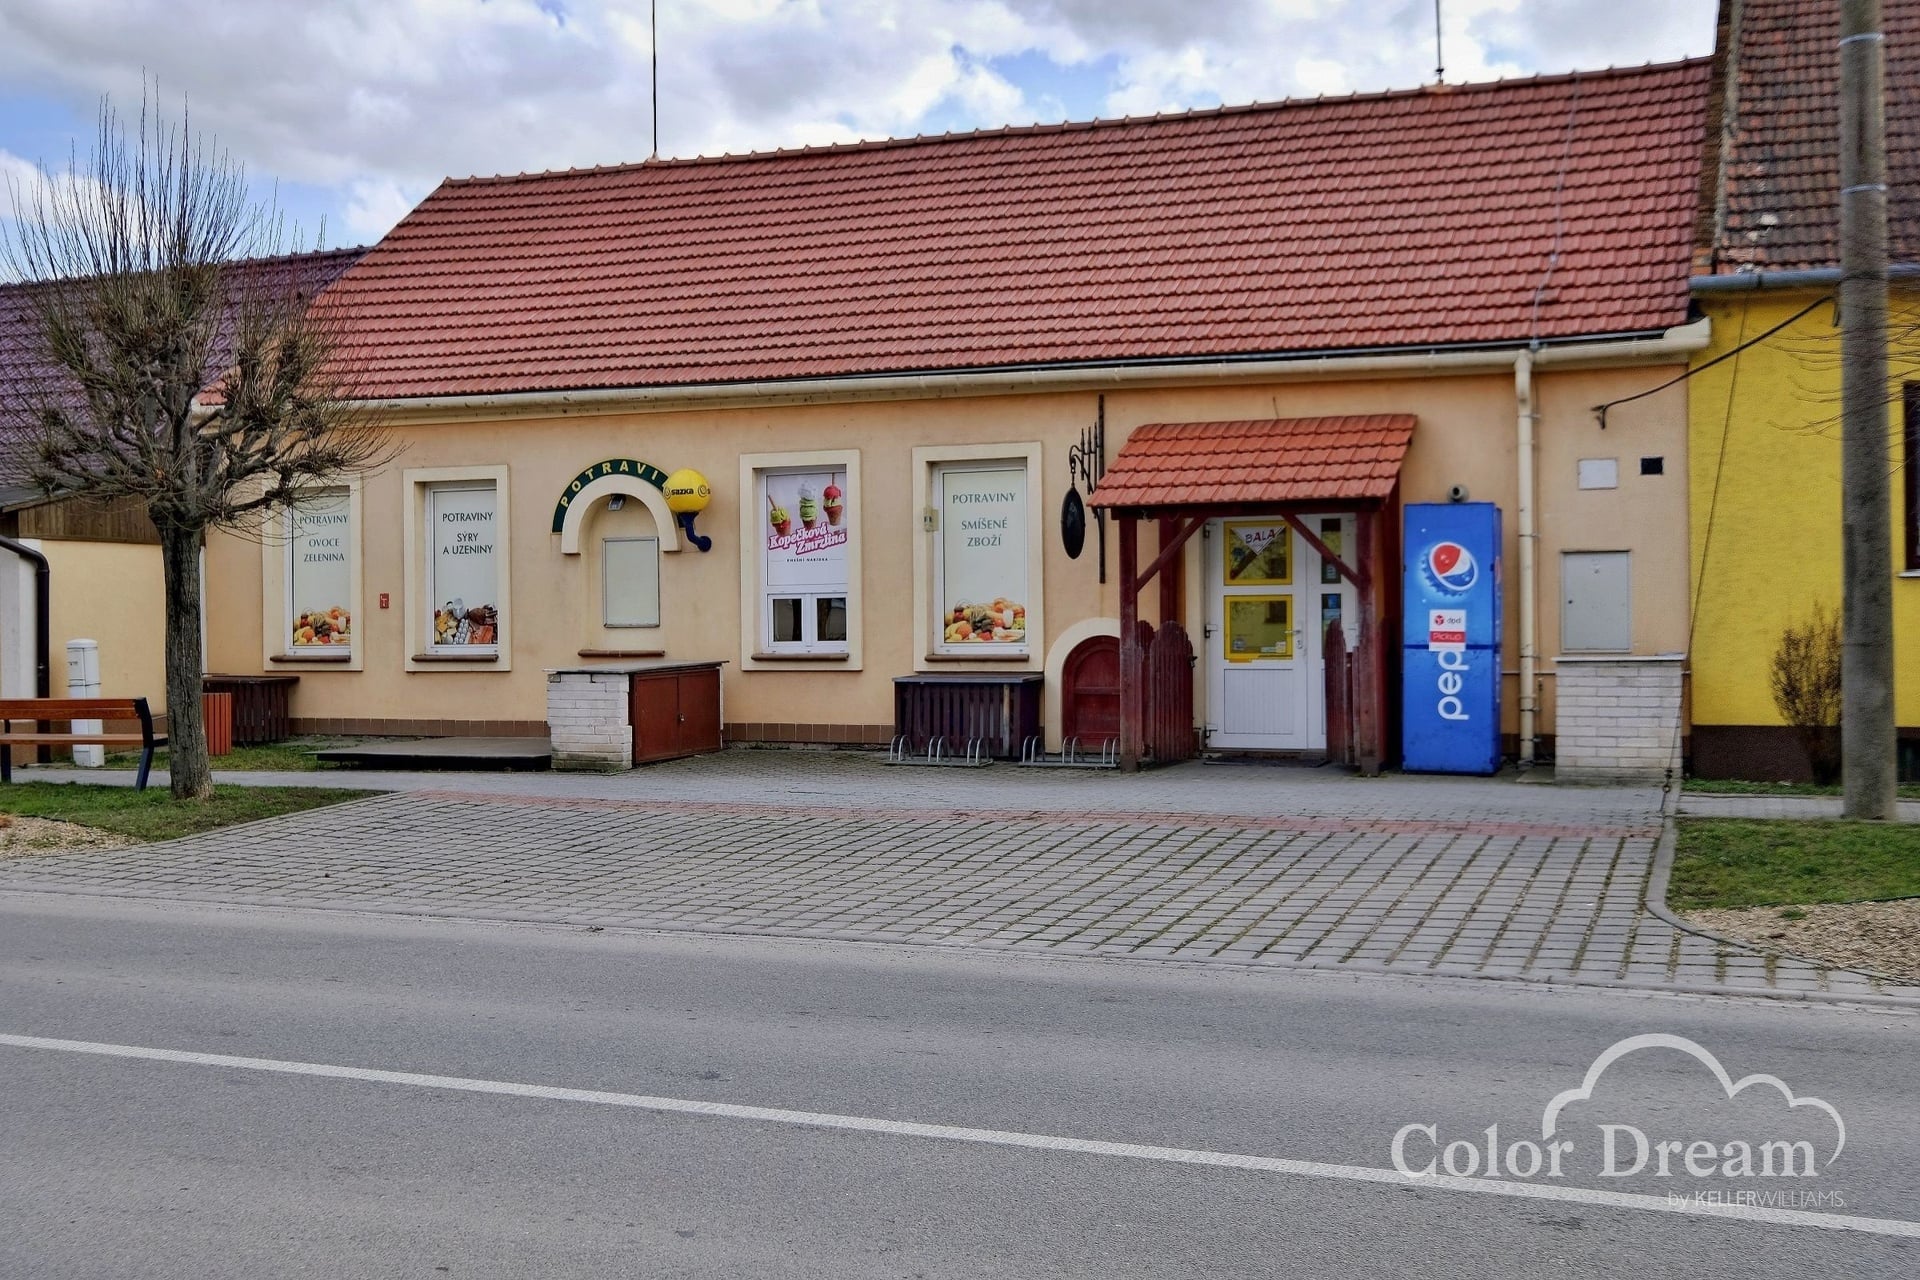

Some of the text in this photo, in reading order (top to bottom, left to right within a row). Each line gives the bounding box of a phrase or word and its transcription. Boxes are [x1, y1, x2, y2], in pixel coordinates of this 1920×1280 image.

[560, 460, 664, 508] POTRAVI
[671, 488, 694, 496] sazka
[951, 492, 1016, 504] POTRAVINY
[299, 514, 348, 525] POTRAVINY
[442, 511, 494, 523] POTRAVINY
[961, 516, 1008, 531] SMÍŠENÉ
[769, 521, 829, 550] Kopečková
[967, 533, 1002, 547] ZBOŽÍ
[1244, 528, 1276, 544] BALA
[308, 538, 340, 548] OVOCE
[796, 531, 847, 555] Zmrzlina
[442, 544, 494, 556] A UZENINY
[303, 552, 346, 563] ZELENINA
[1446, 617, 1462, 625] dpd
[1437, 649, 1470, 721] pep
